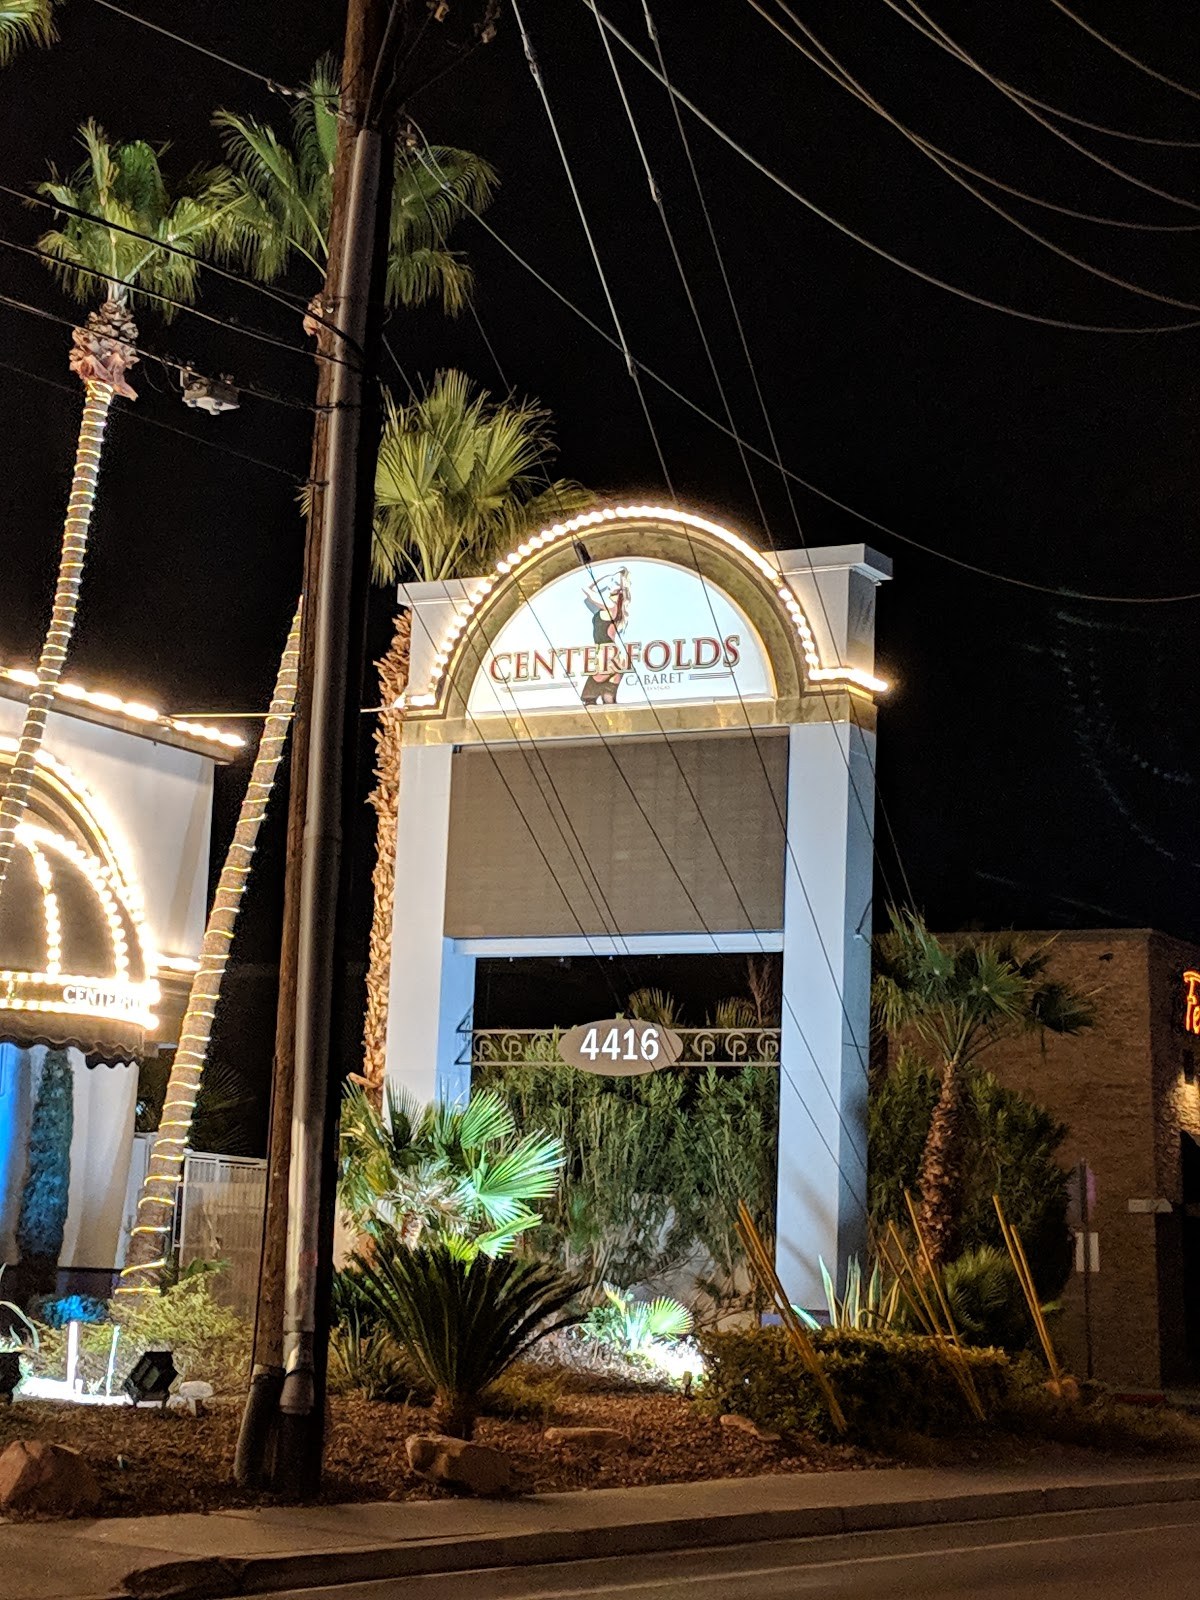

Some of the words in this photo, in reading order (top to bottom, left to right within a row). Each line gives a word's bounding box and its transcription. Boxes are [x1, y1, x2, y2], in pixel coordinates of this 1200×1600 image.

[489, 635, 739, 683] CENTERFOLDS
[625, 672, 684, 686] CABARET
[580, 1028, 659, 1060] 4416
